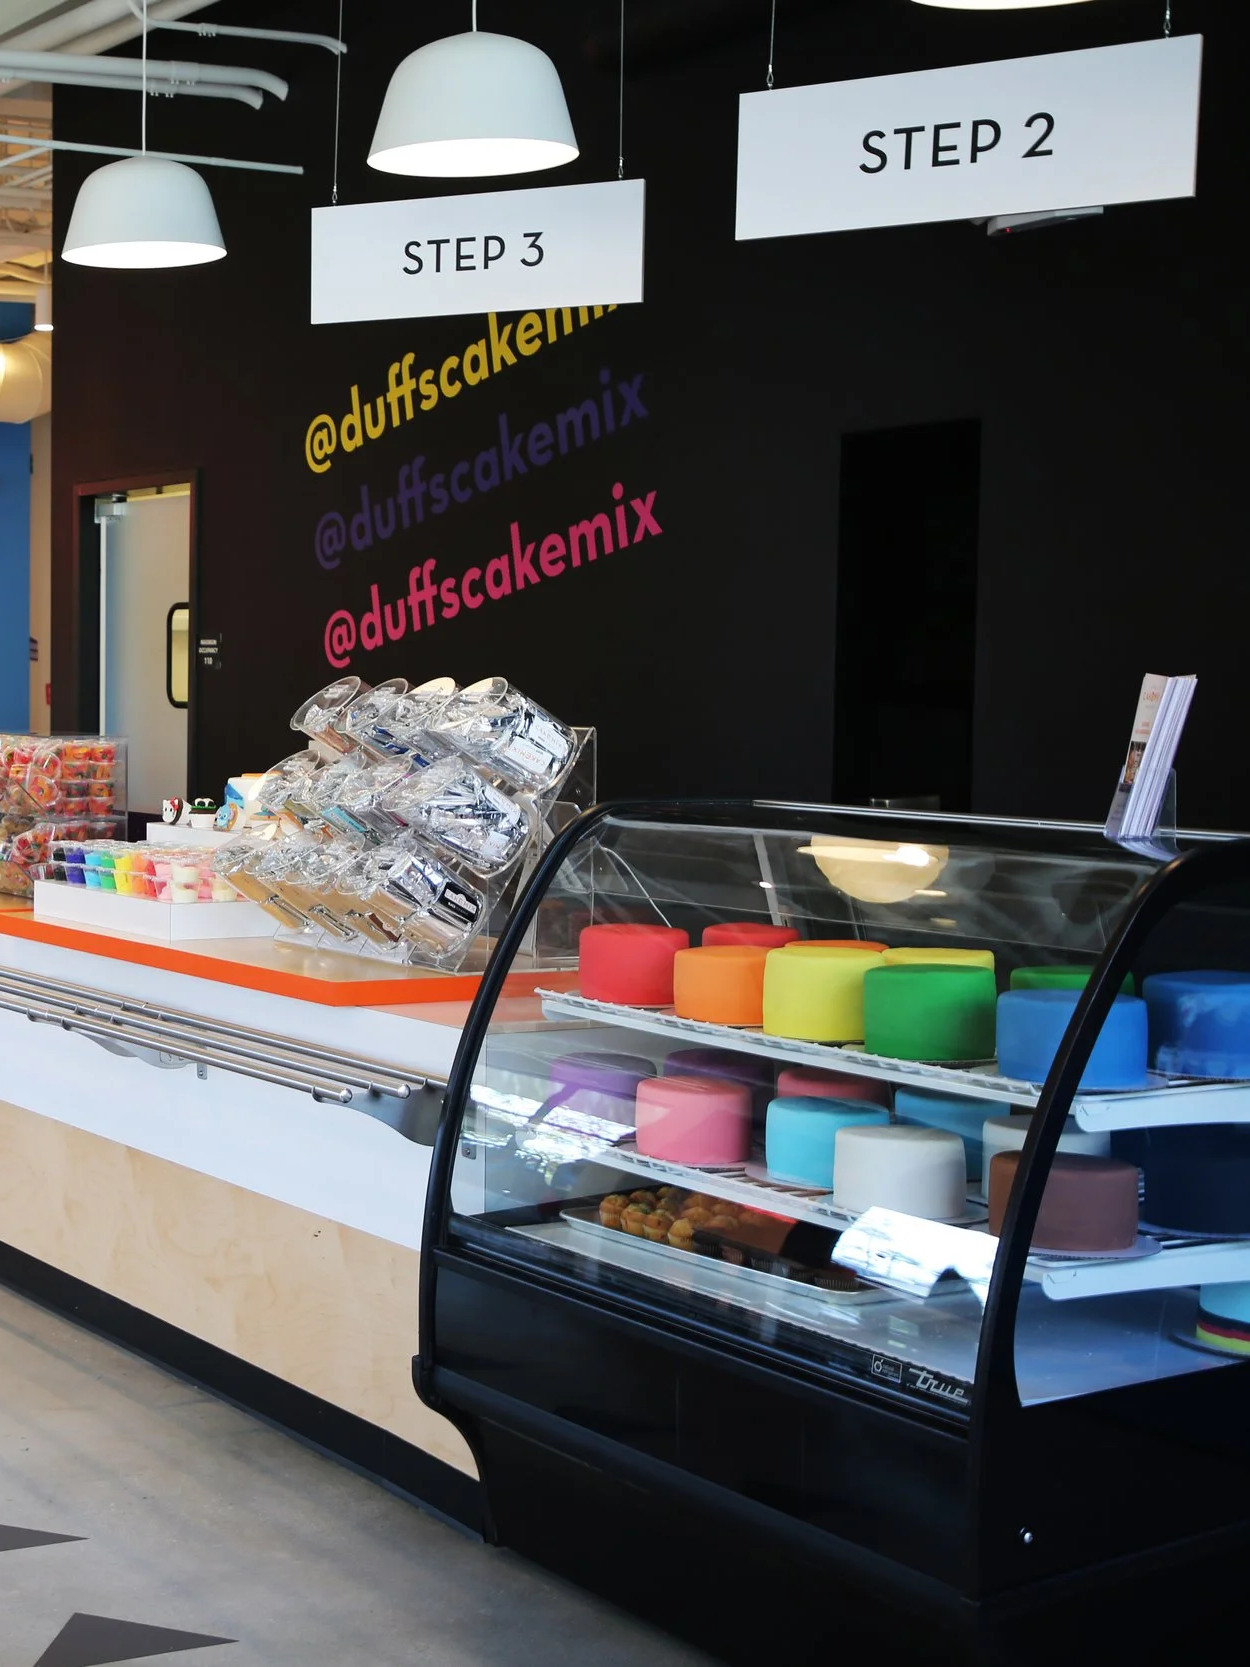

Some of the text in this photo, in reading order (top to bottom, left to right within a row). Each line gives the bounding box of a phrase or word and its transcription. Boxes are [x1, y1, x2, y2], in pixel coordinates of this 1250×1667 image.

[859, 112, 1055, 174] STEP 2
[402, 231, 545, 275] STEP 3
[305, 304, 618, 473] @duffscakem
[314, 366, 649, 570] @duffscakemix
[324, 482, 663, 669] @duffscakemix
